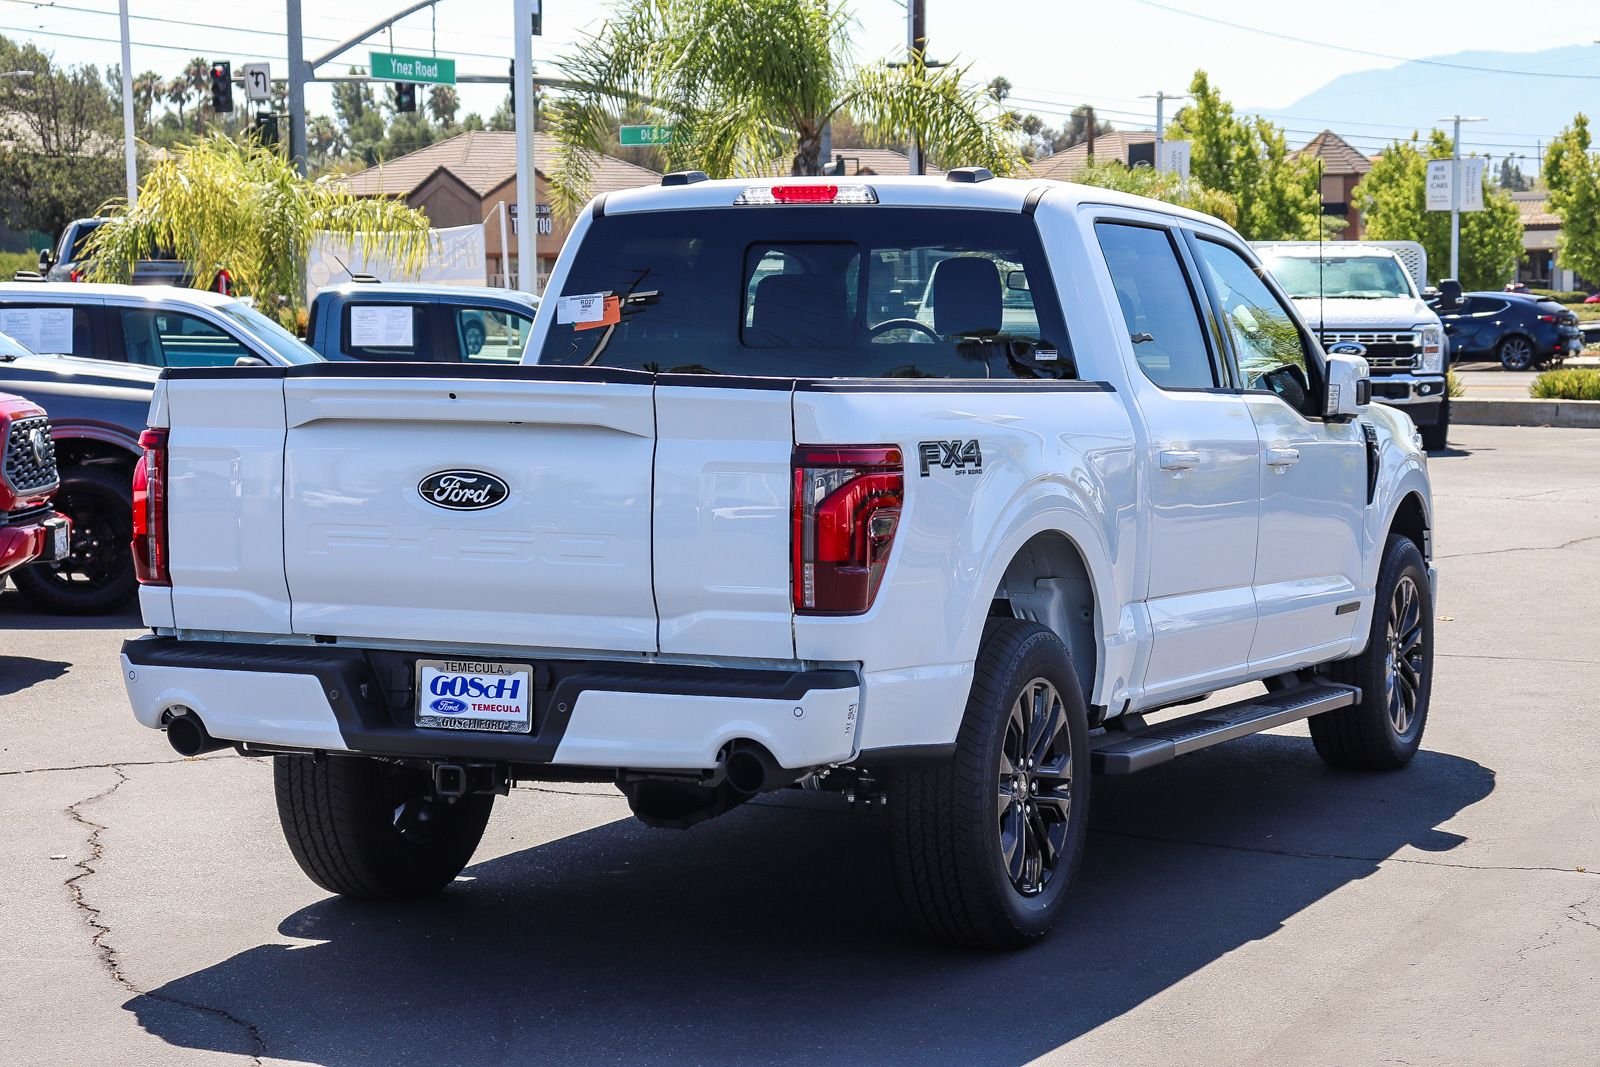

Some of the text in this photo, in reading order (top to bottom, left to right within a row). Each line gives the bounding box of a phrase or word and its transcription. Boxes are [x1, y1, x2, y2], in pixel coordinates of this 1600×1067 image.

[391, 58, 438, 77] Ynez Road
[511, 217, 552, 233] TOO
[918, 439, 982, 477] FX4
[433, 474, 492, 504] Ford
[443, 661, 505, 674] TEMECULA
[437, 700, 460, 712] Ford
[471, 703, 521, 713] TEMECULA
